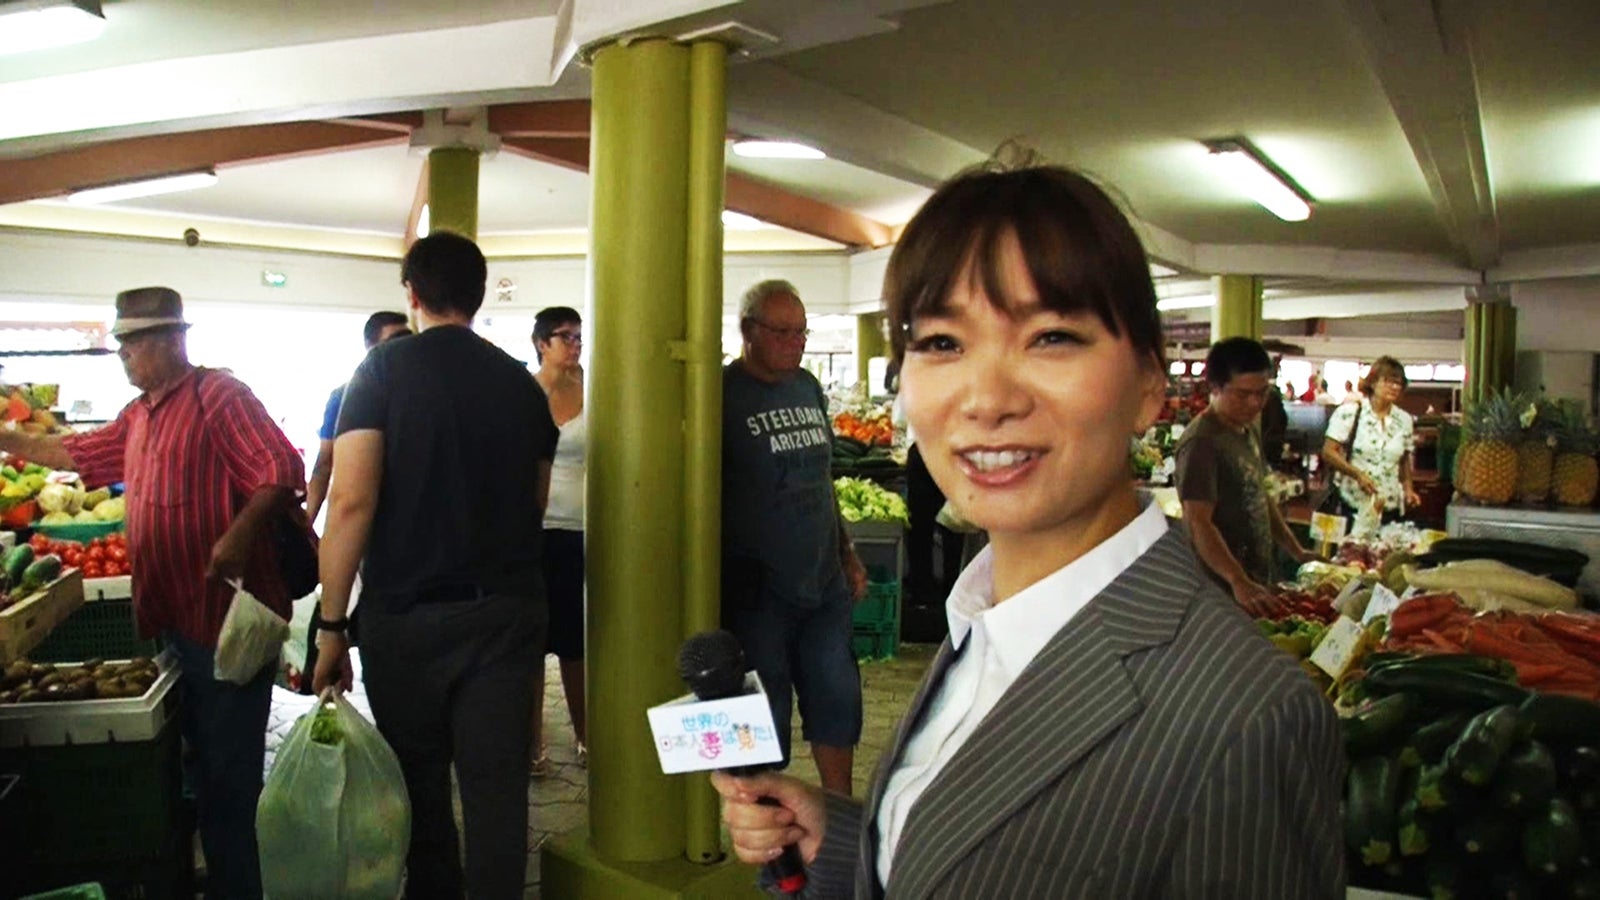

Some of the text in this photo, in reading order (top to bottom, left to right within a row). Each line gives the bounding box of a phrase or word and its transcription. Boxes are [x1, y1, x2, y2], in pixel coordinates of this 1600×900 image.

[769, 428, 827, 453] ARIZONA
[682, 712, 729, 732] 世界の
